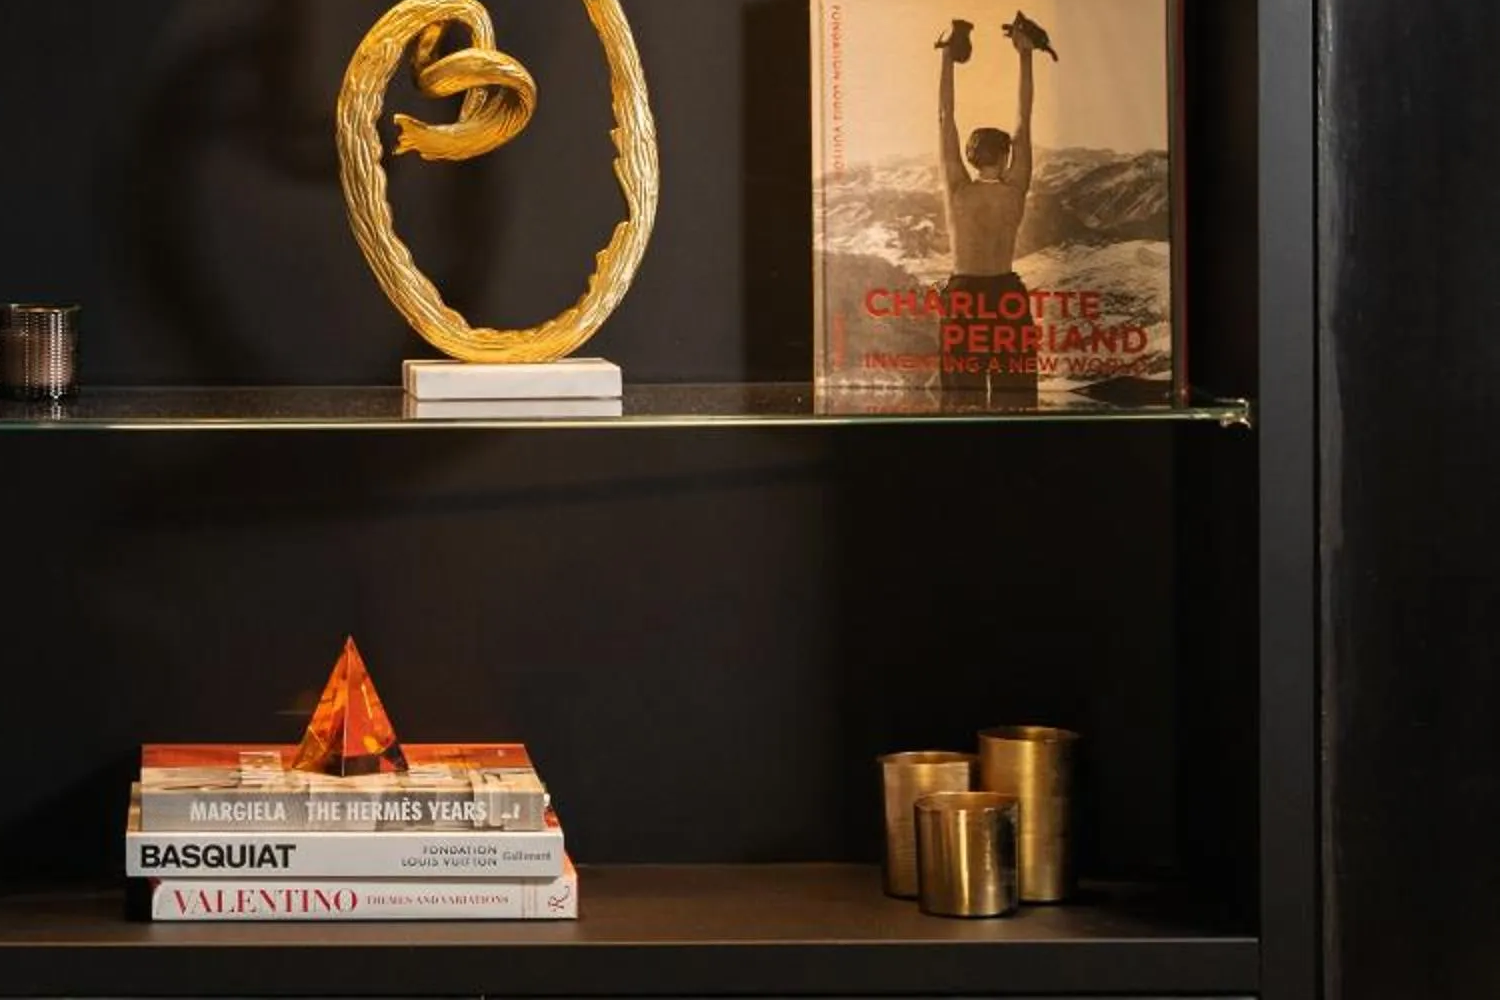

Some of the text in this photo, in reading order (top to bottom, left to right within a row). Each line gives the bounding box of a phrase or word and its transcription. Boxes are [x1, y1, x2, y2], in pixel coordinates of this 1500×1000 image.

[865, 288, 1101, 320] CHARLOTTE
[943, 324, 1148, 355] PERRIAND
[1008, 355, 1058, 375] NEW
[190, 797, 488, 822] MARGIELA THE HERMÈS YEARS
[140, 844, 297, 869] BASQUIAT
[401, 857, 439, 867] LOUIS
[422, 845, 498, 855] FONDATION
[174, 889, 358, 914] VALENTINO
